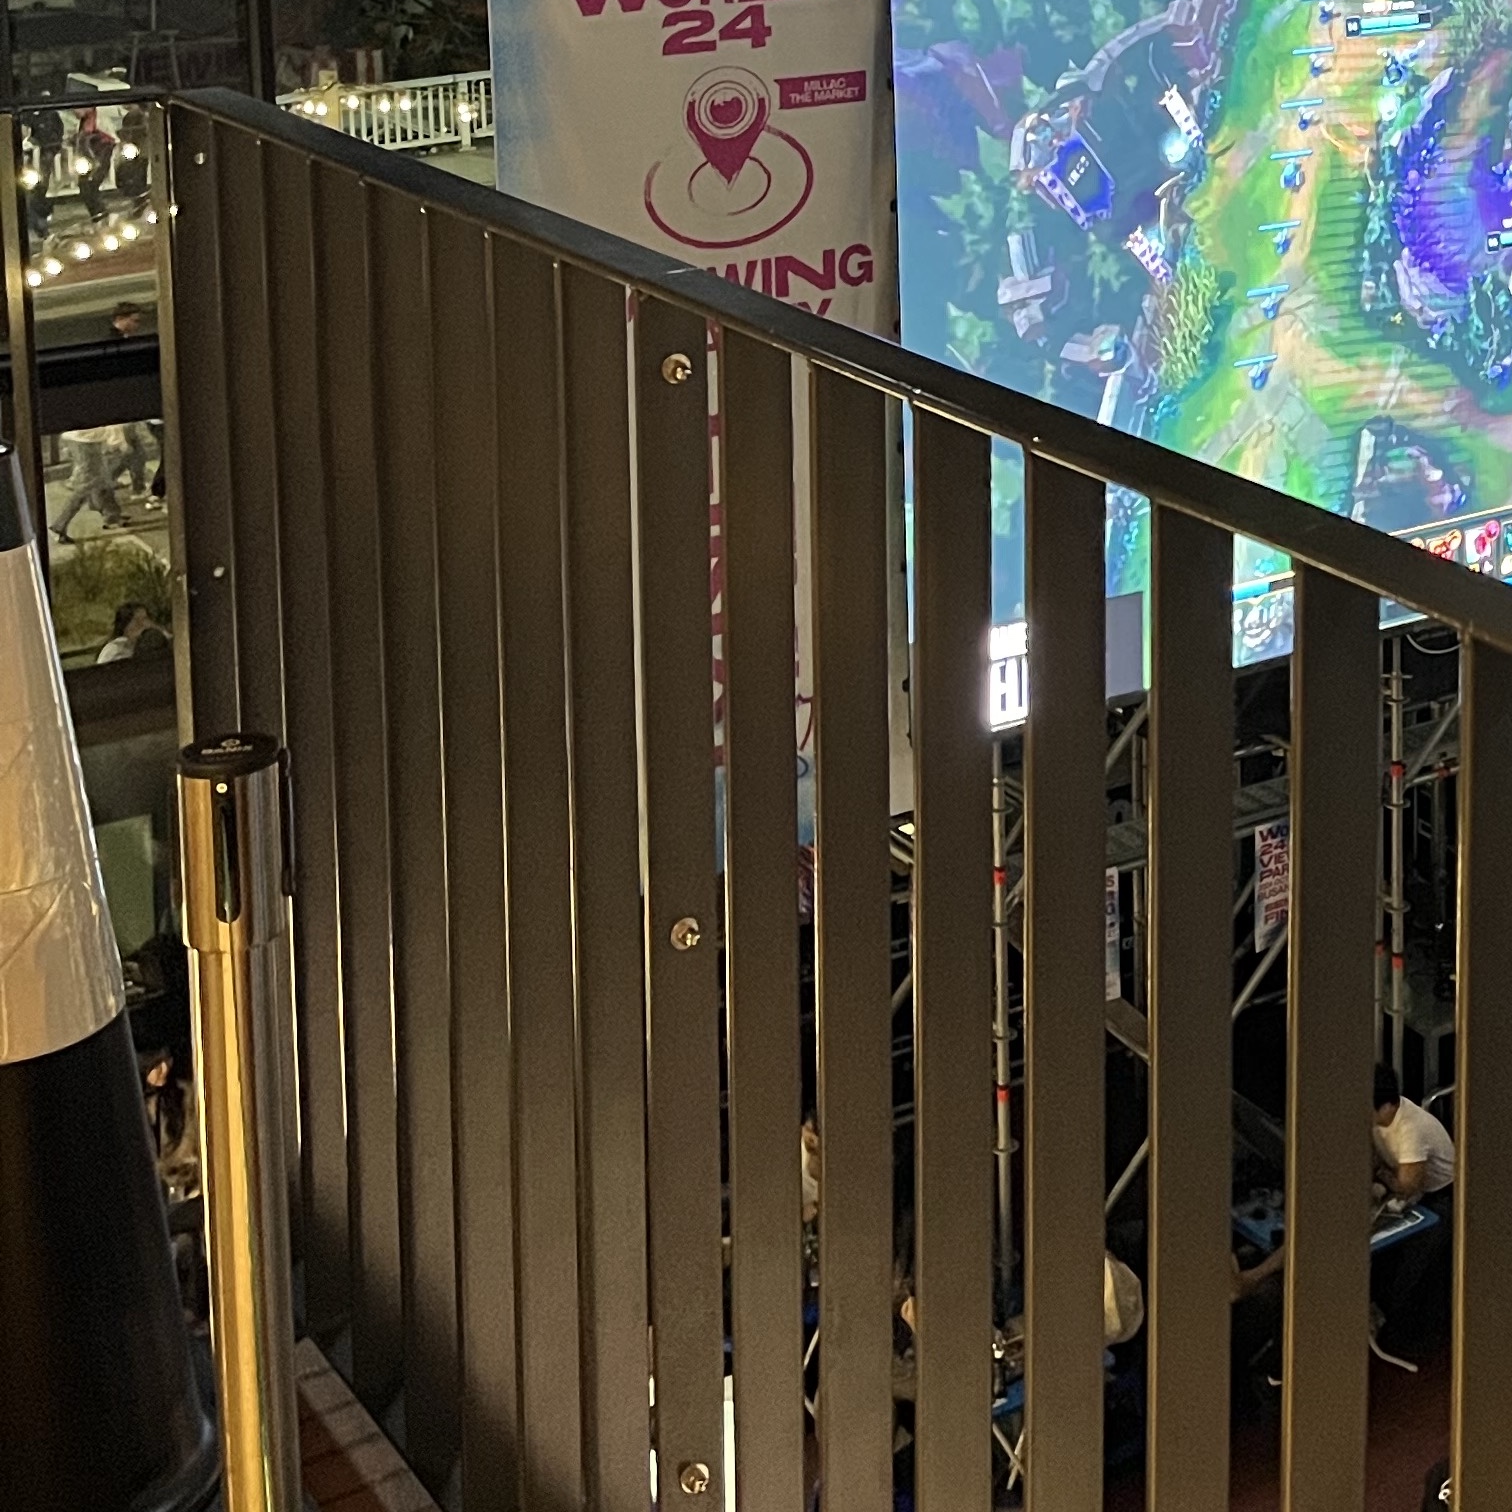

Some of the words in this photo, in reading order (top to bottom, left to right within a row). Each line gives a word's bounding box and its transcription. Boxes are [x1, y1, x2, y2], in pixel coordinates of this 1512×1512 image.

[662, 5, 772, 56] 24
[789, 91, 813, 104] THE
[814, 87, 860, 101] MARKET
[706, 244, 873, 297] WING
[1261, 840, 1287, 856] 24
[1260, 864, 1289, 882] PAR
